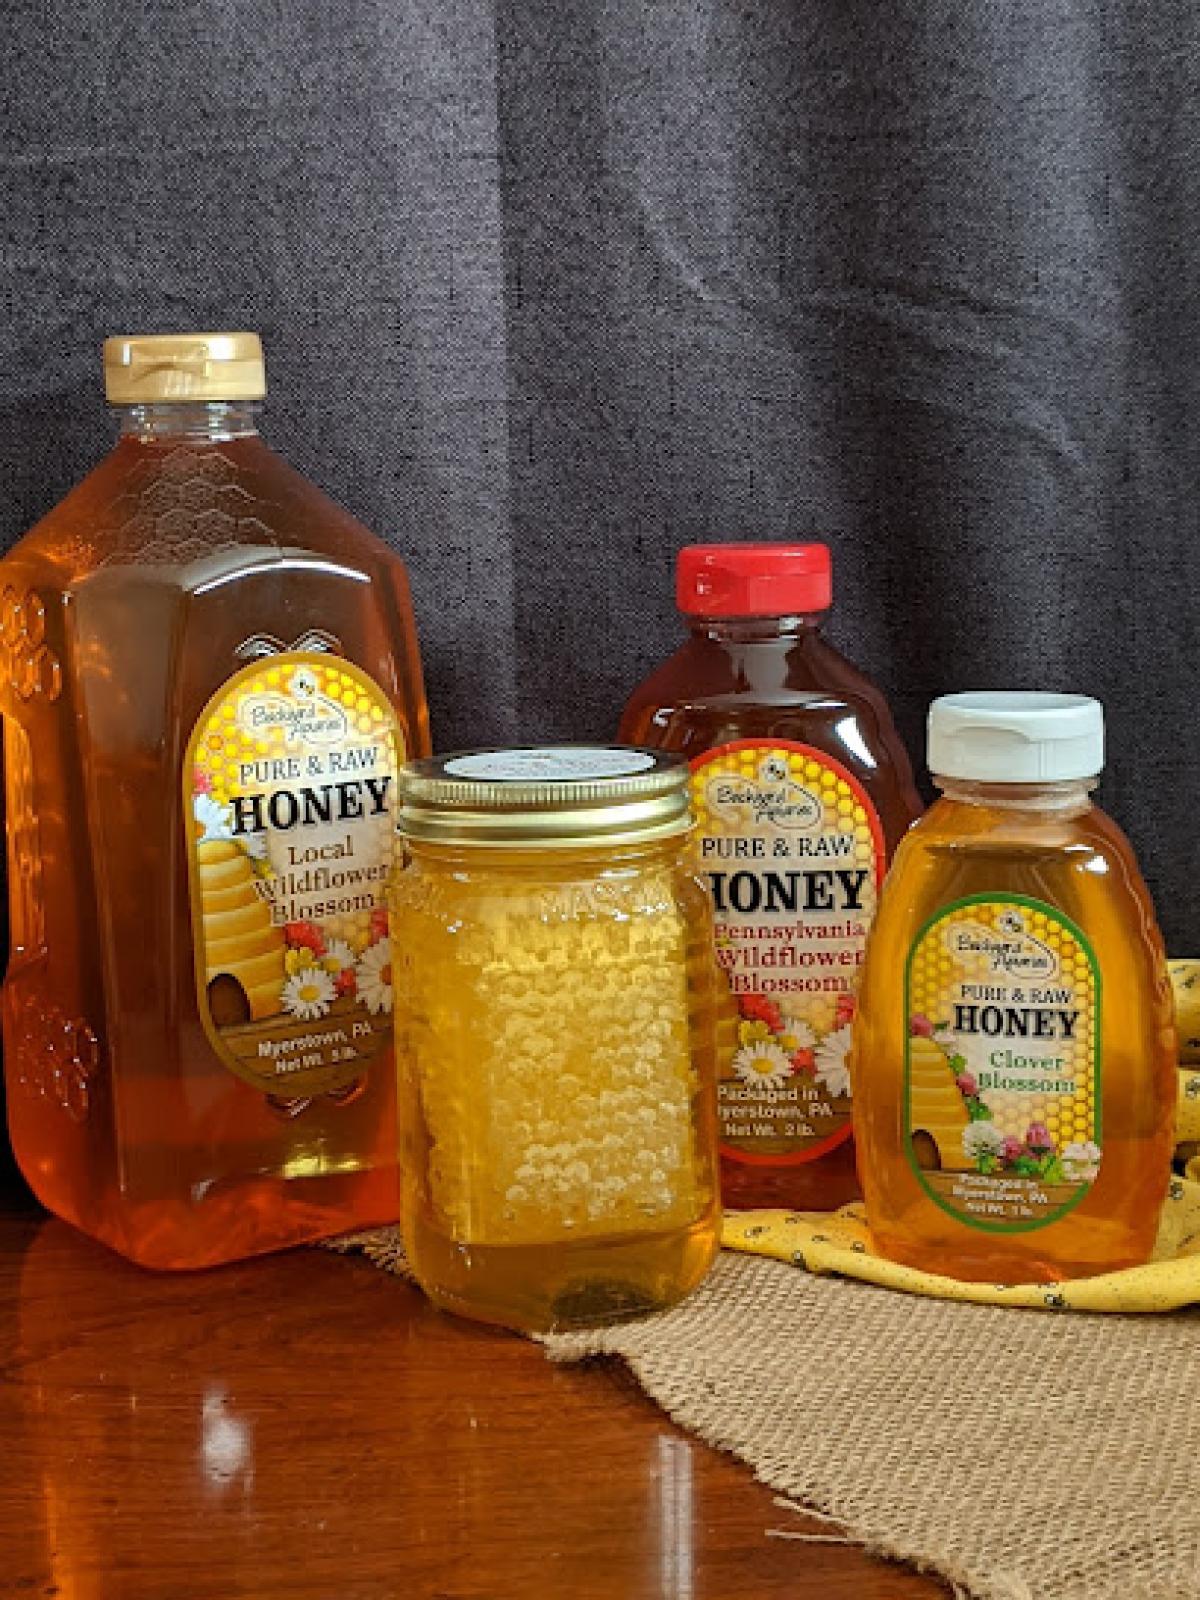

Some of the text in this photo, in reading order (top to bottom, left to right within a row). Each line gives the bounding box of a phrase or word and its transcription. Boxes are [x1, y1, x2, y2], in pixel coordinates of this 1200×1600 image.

[240, 747, 377, 785] PURE & RAW
[229, 776, 391, 835] HONEY
[287, 834, 354, 865] Local
[702, 835, 853, 857] PURE & RAW
[253, 864, 390, 902] Wildflower
[270, 893, 375, 926] Blossom
[714, 920, 866, 942] Pennsylvania
[717, 946, 864, 969] Wildflower
[731, 973, 848, 992] Blossom
[961, 984, 1072, 1004] PURE & RAW
[953, 1004, 1079, 1038] HONEY
[990, 1050, 1065, 1070] Clover
[978, 1071, 1076, 1092] Blossom
[808, 1102, 833, 1118] PA
[726, 1122, 751, 1136] Net
